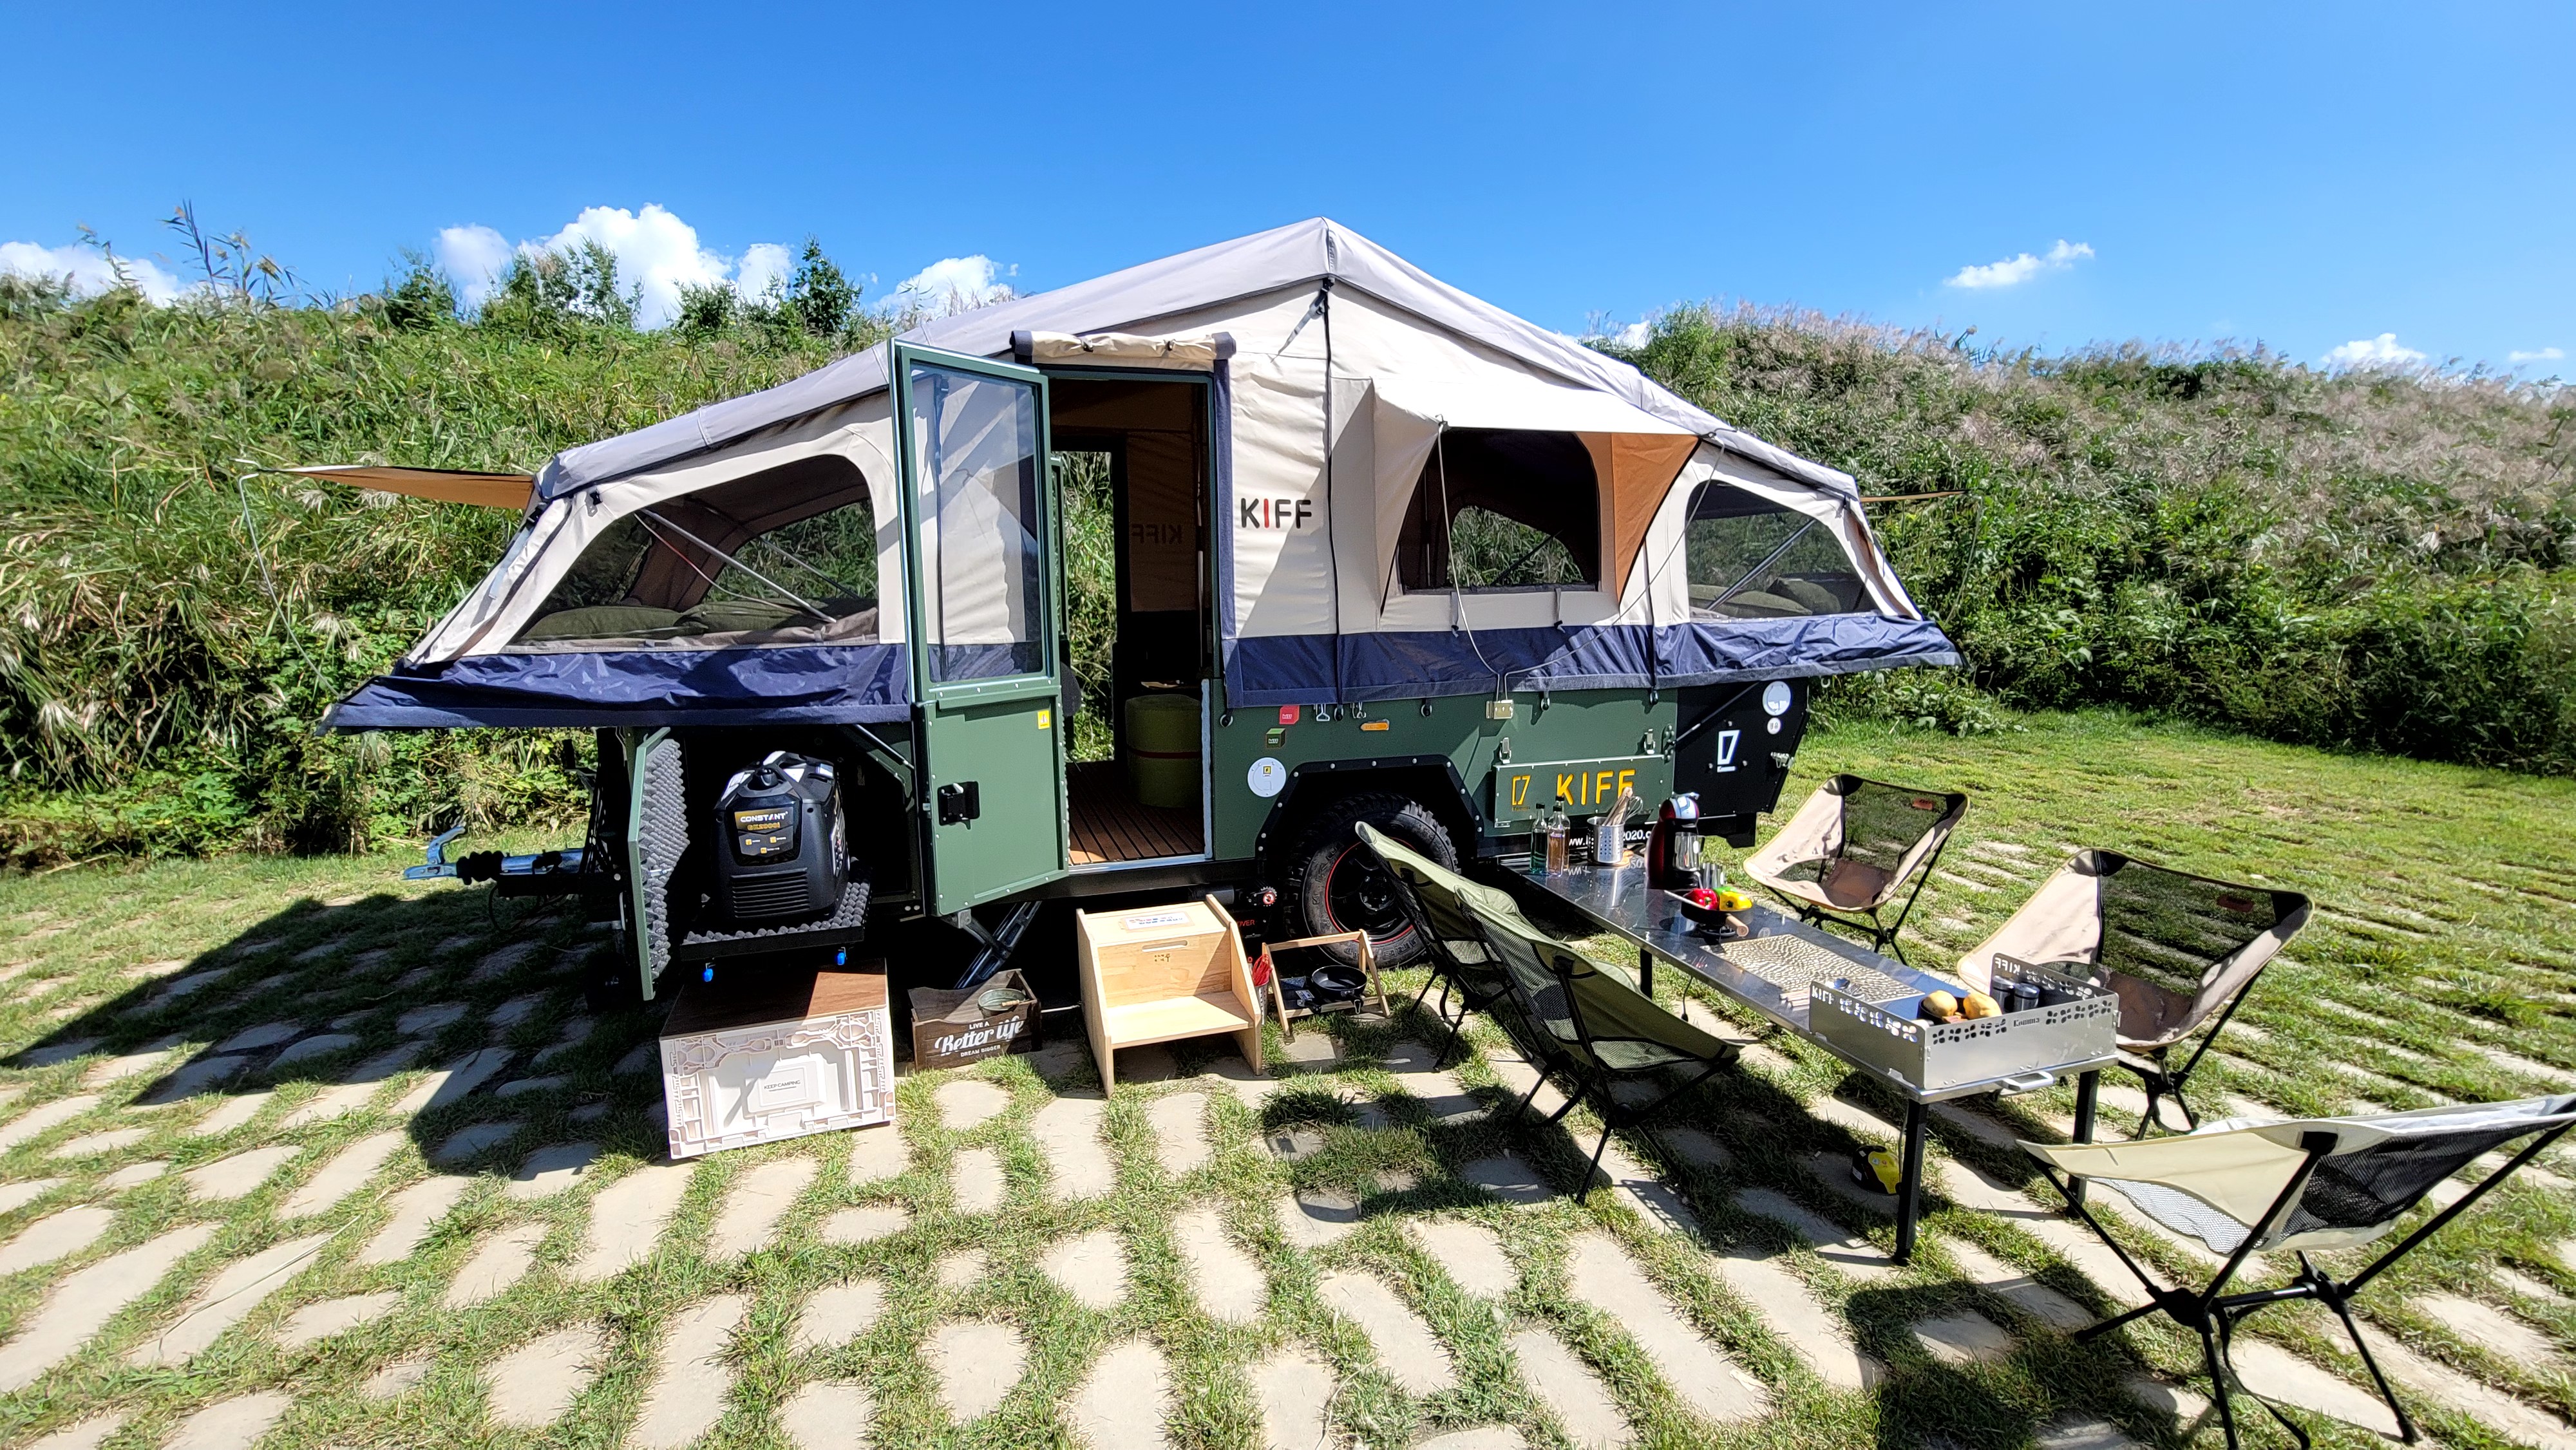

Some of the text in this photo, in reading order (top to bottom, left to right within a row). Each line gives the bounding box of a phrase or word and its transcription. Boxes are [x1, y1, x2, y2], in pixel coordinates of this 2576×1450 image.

[1240, 498, 1312, 529] KIFF
[740, 813, 786, 823] CONSTANT
[934, 1029, 994, 1057] Better
[960, 1044, 1001, 1057] DREAM BIGGER
